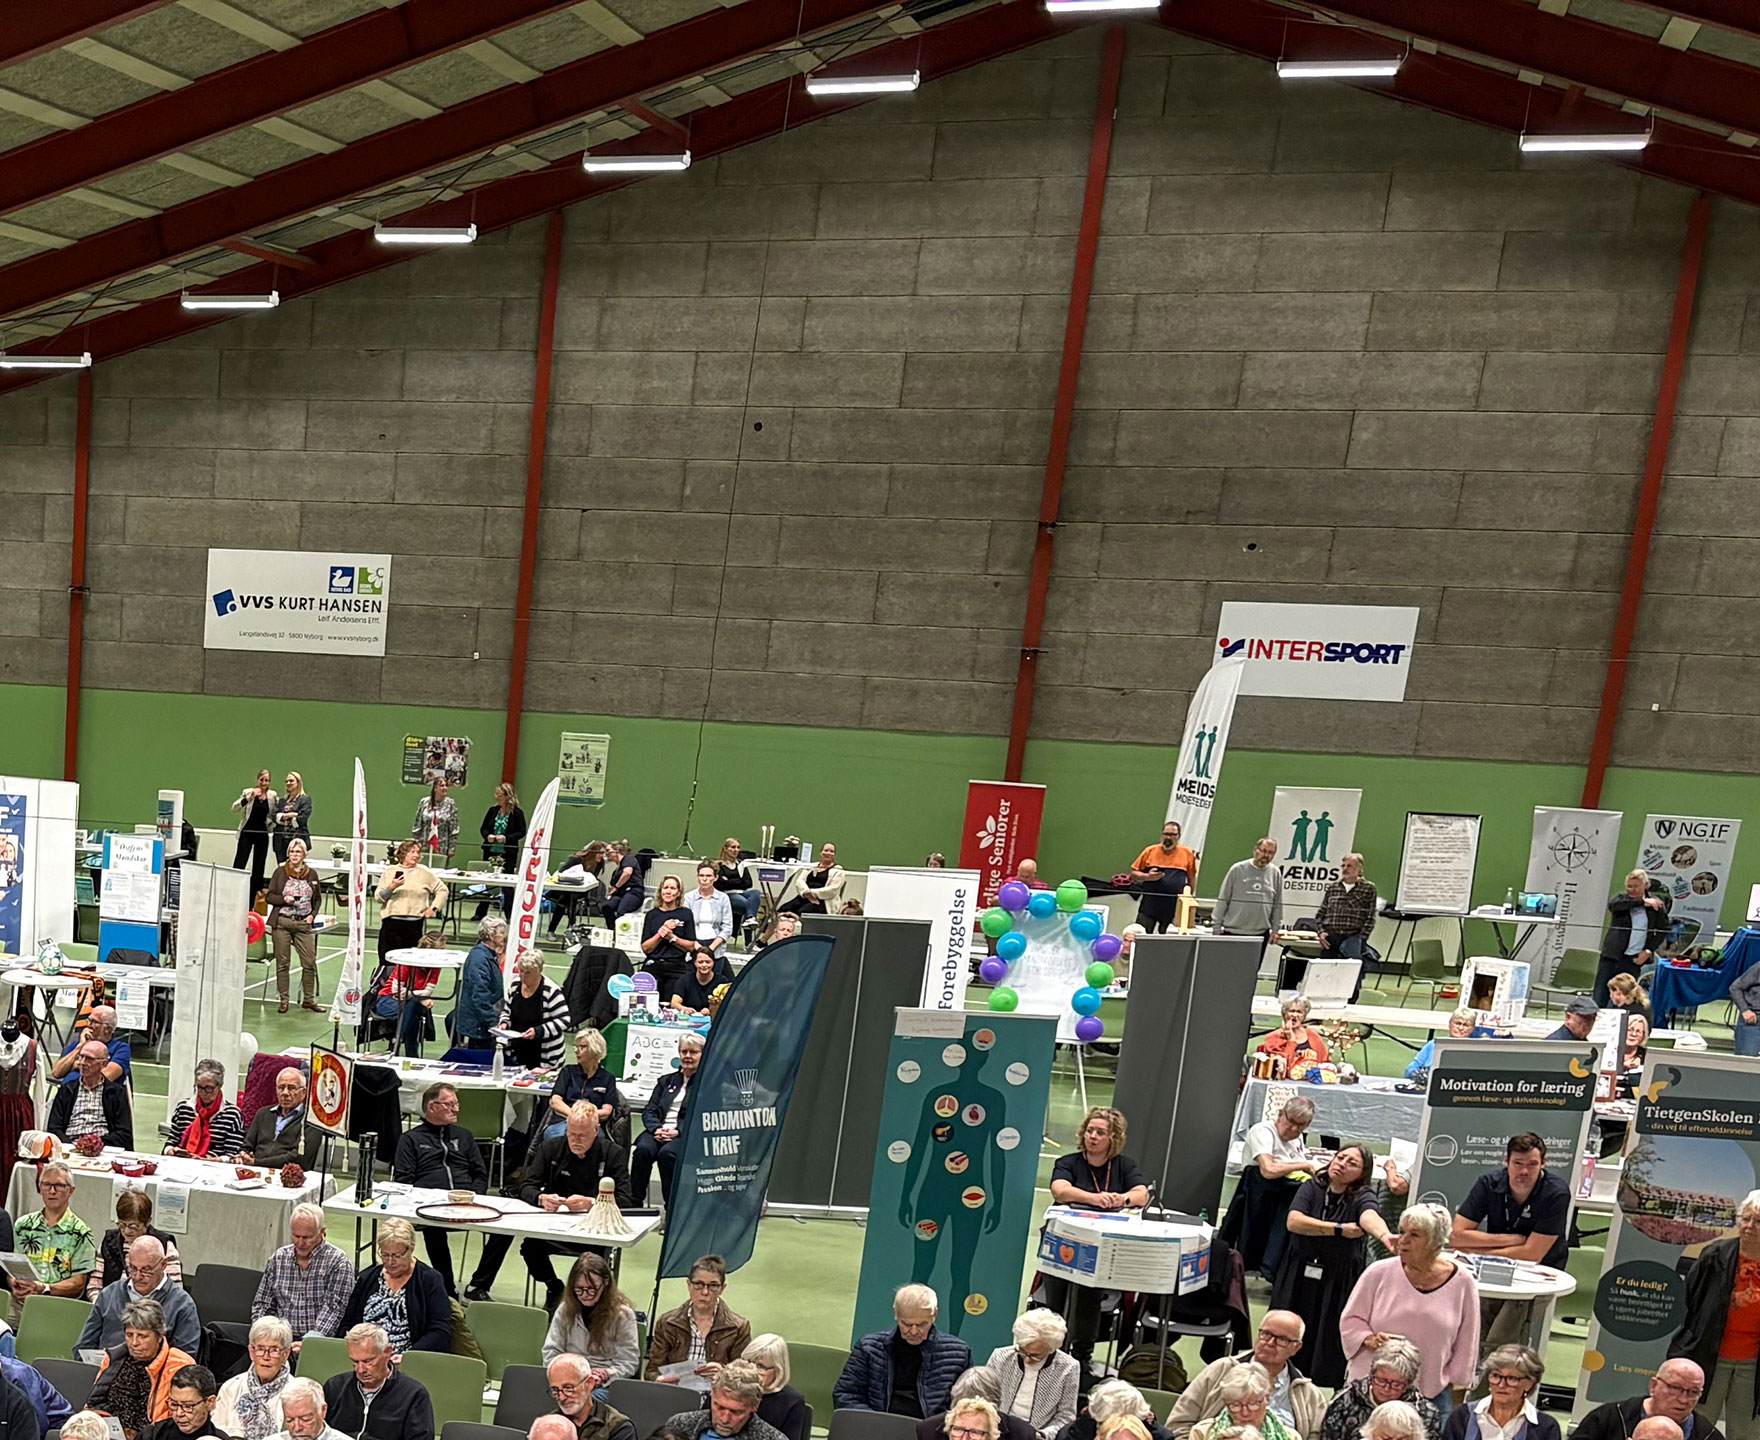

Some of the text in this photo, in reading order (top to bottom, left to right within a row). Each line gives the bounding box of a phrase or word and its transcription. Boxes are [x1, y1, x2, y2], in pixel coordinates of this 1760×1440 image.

[239, 595, 382, 613] VVS KURT HANSEN
[1247, 638, 1406, 665] INTERSPORT
[988, 798, 1011, 866] Seniorer
[1678, 821, 1731, 840] NGIF
[938, 888, 967, 1010] Forebyggelse
[1439, 1078, 1587, 1097] Motivation for læring
[701, 1106, 777, 1132] BADMINTON
[1644, 1106, 1754, 1124] TietgenSkolen
[1651, 1122, 1664, 1130] din
[1665, 1124, 1678, 1132] vej
[1678, 1123, 1687, 1131] til
[703, 1135, 741, 1157] I KRIF
[1490, 1137, 1501, 1146] og
[1616, 1277, 1669, 1291] Er du ledig?
